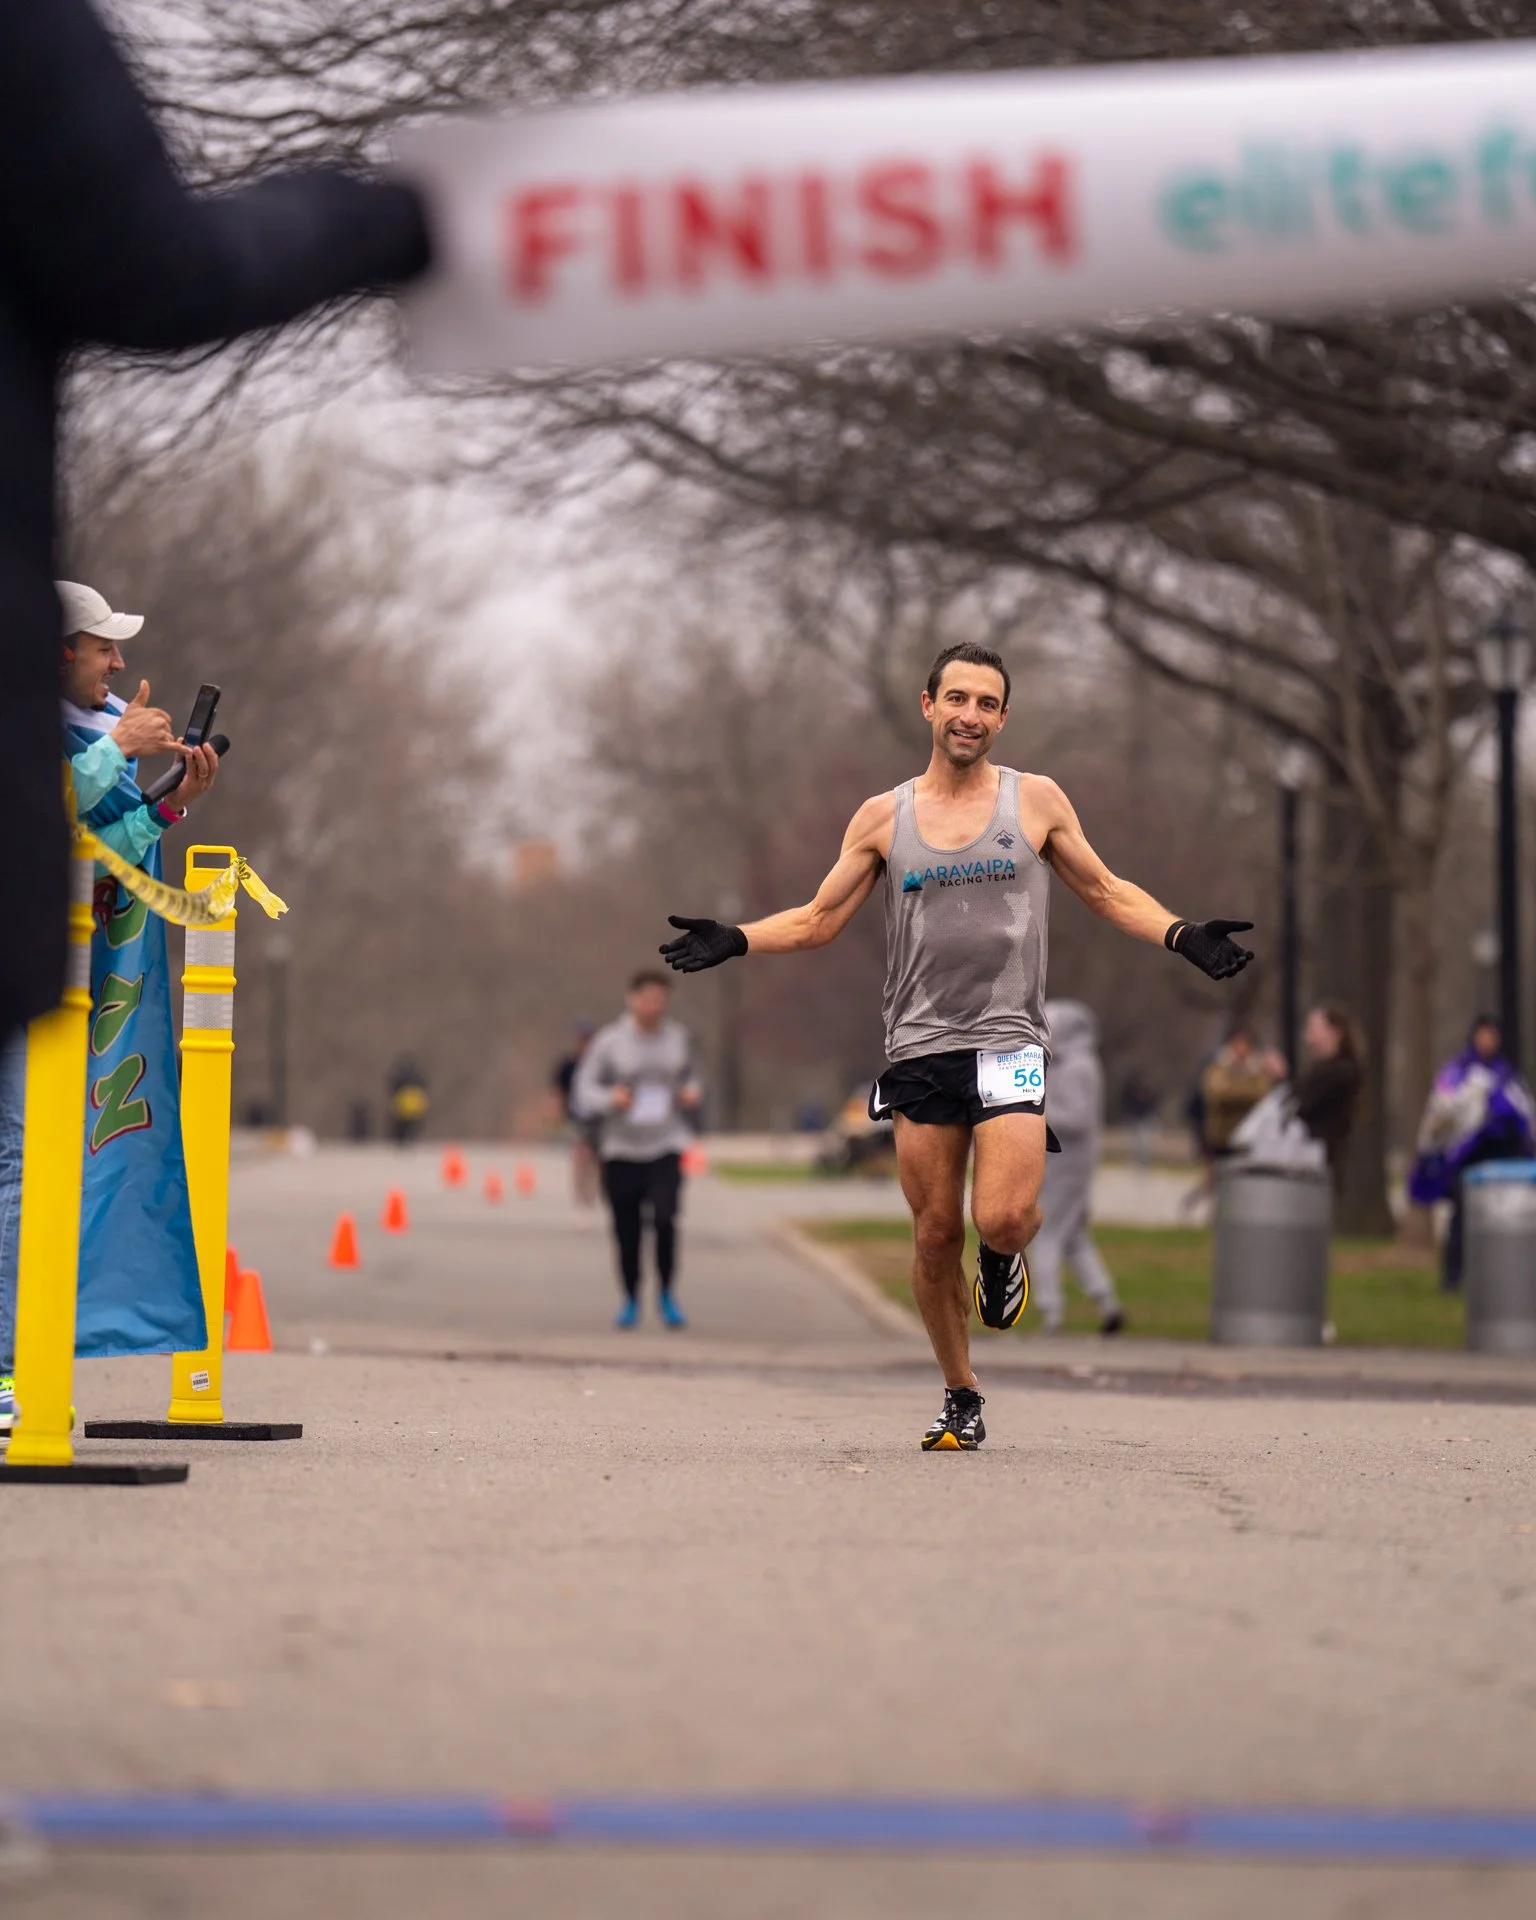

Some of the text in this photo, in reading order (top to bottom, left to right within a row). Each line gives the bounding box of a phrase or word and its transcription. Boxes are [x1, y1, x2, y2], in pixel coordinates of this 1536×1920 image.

[507, 150, 1078, 304] FINISH
[923, 859, 1016, 881] ARAVAIPA
[939, 873, 1016, 888] RACING TEAM
[997, 1051, 1043, 1063] QUEENS MARA
[1014, 1068, 1042, 1087] 56
